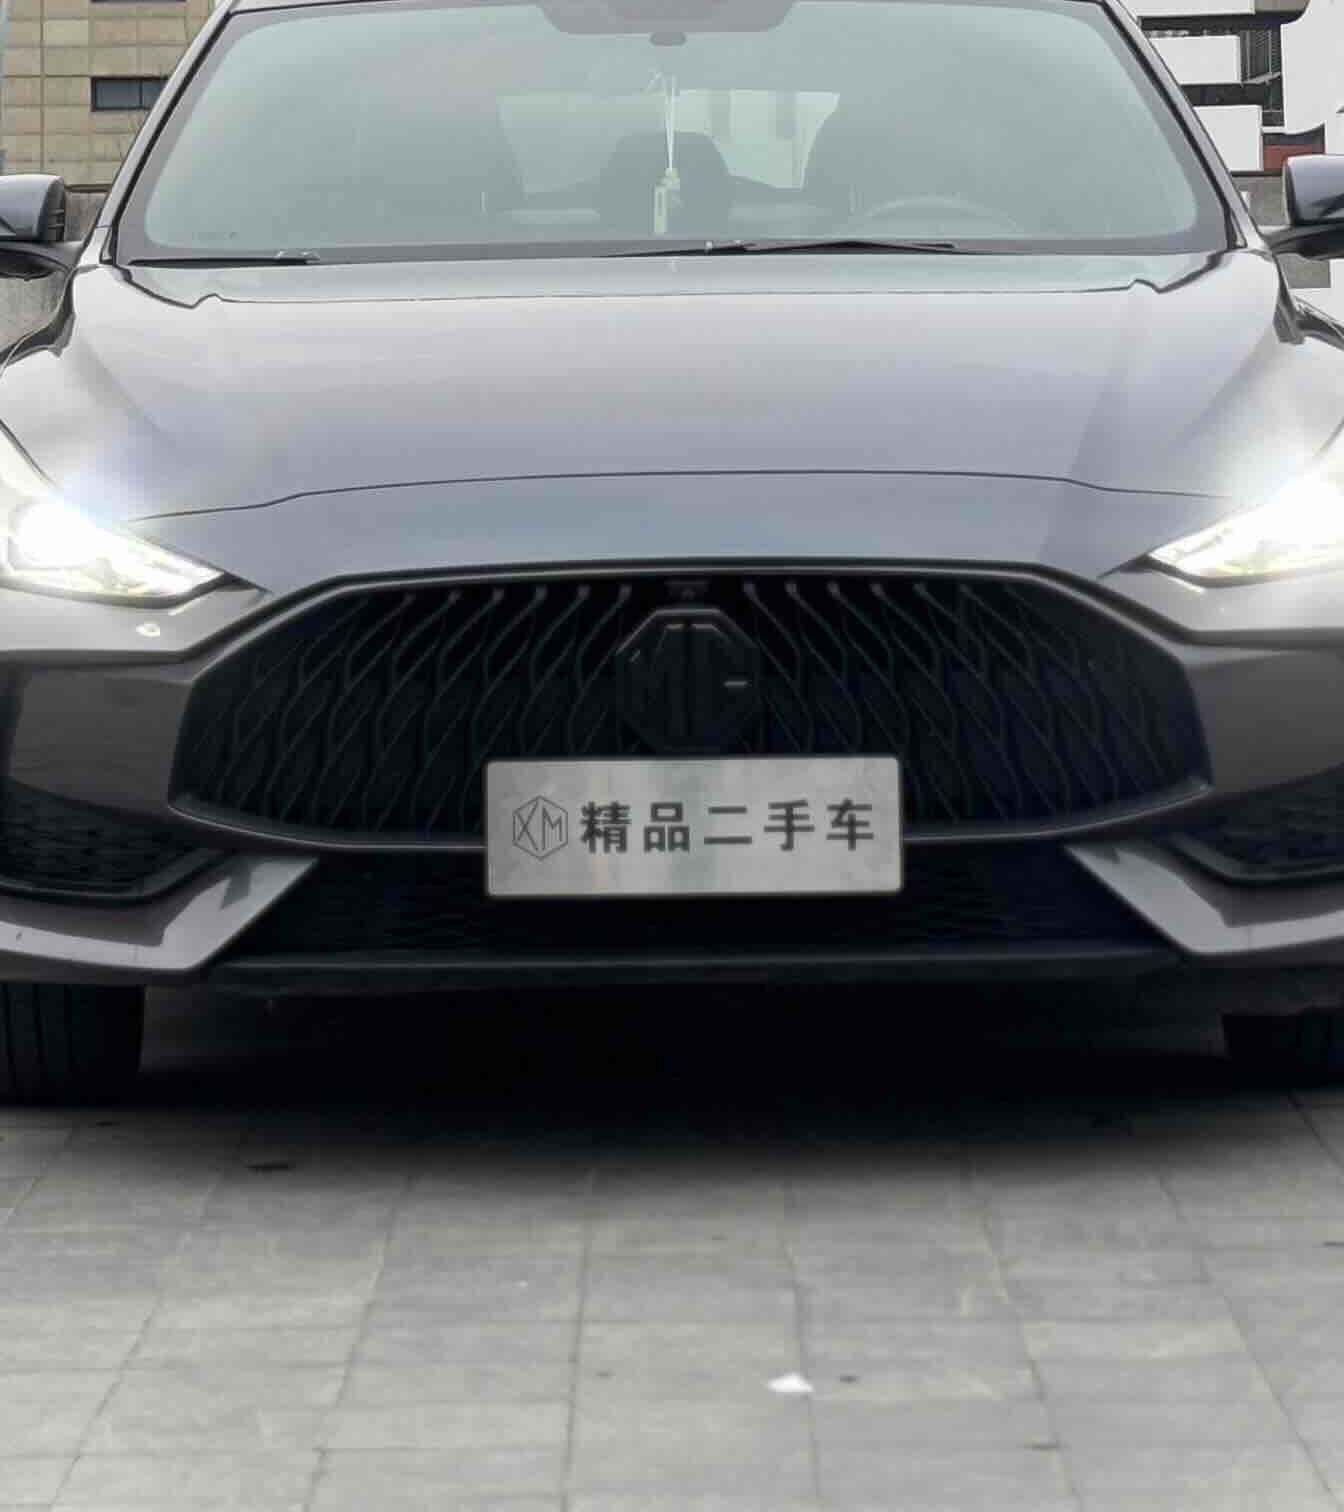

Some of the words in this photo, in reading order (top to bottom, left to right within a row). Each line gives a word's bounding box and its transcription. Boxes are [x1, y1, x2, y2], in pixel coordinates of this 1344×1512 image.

[580, 798, 875, 854] 精品二手车
